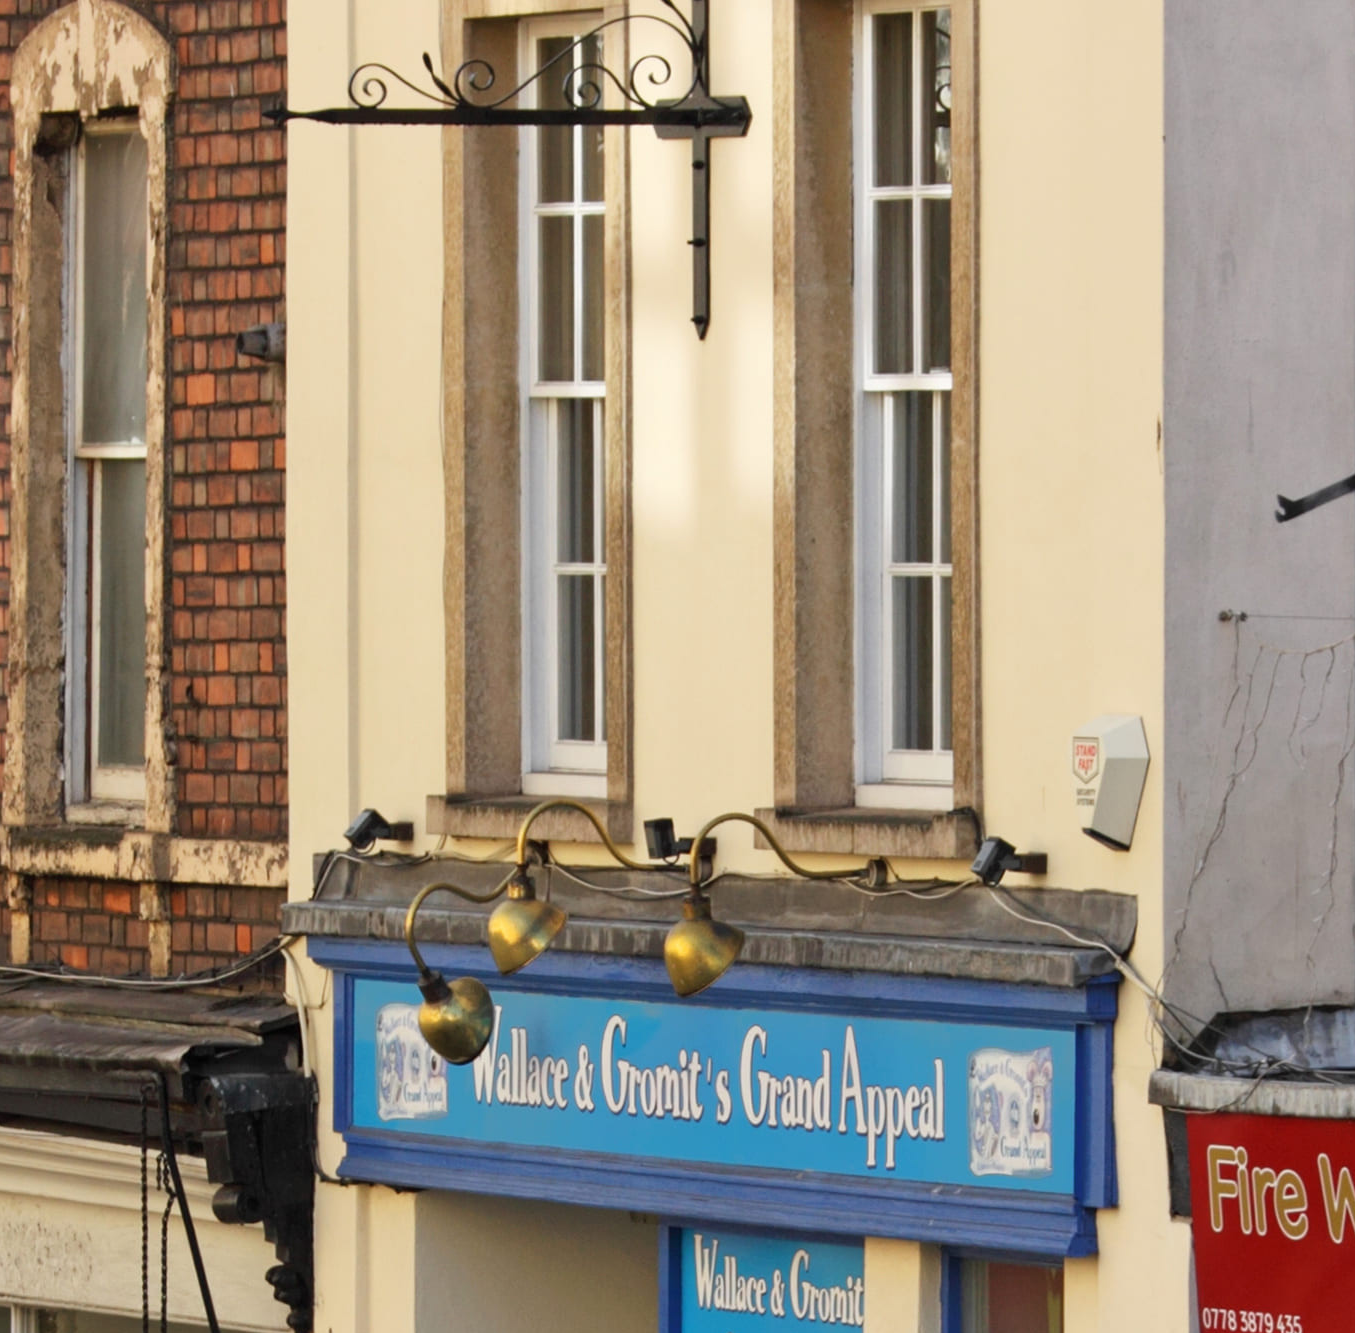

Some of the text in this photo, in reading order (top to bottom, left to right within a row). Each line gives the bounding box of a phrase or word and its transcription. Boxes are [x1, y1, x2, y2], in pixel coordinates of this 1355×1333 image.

[1075, 744, 1097, 757] STAND
[473, 1006, 568, 1110] Wallace
[575, 1046, 594, 1111] &
[741, 1025, 830, 1129] Grand
[839, 1025, 945, 1169] Appeal
[1207, 1144, 1308, 1240] Fire
[694, 1234, 766, 1315] Wallace
[770, 1269, 786, 1317] &
[1202, 1307, 1237, 1332] 0778
